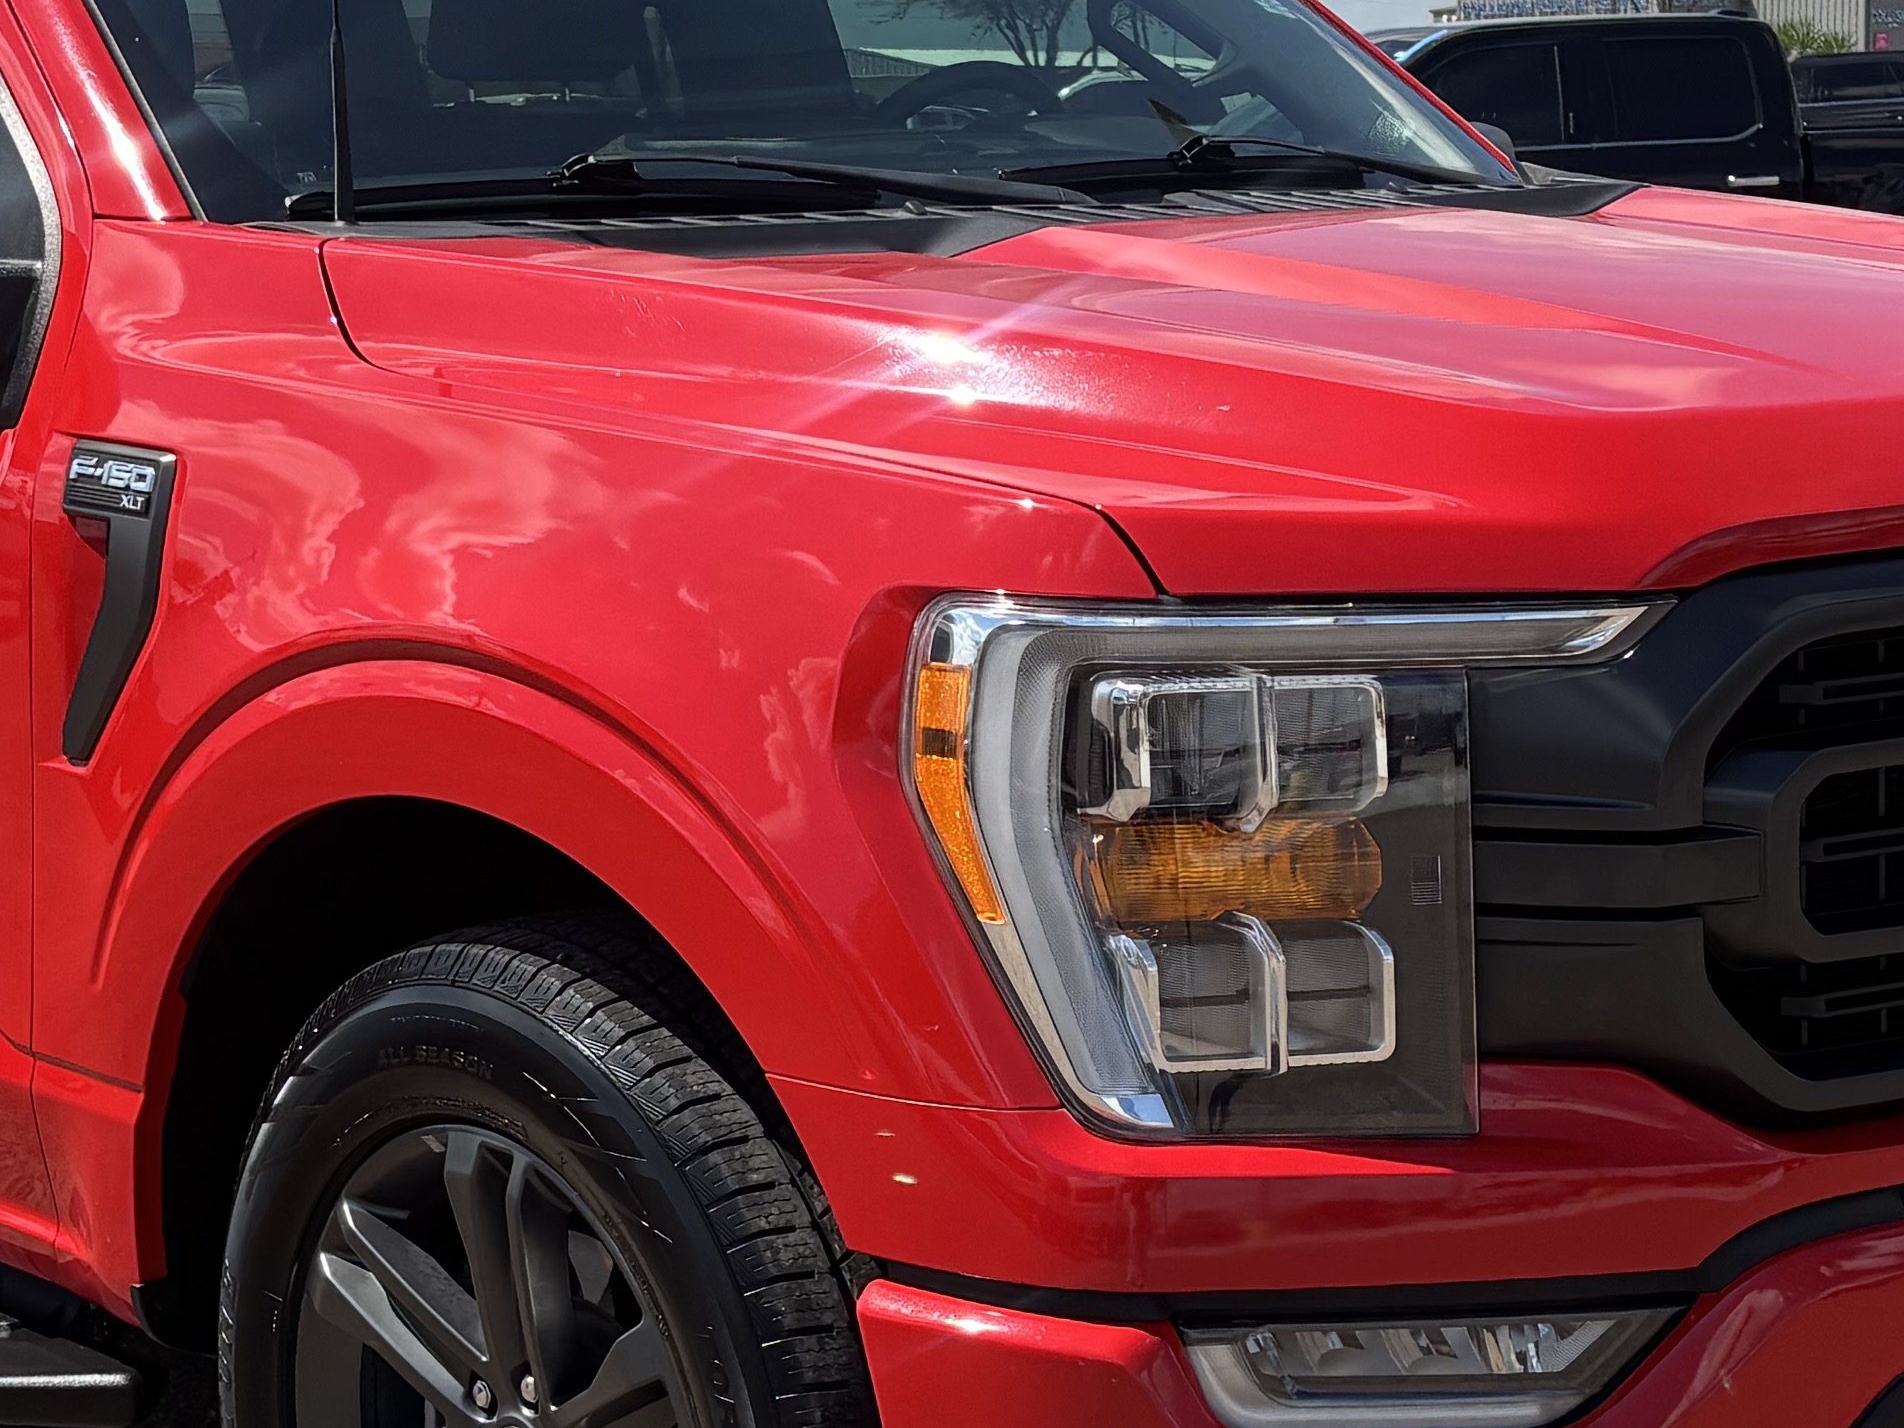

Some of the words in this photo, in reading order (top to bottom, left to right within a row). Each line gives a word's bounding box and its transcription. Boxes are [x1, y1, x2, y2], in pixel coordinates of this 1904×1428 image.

[69, 455, 156, 492] F-150
[119, 494, 145, 510] XLT
[416, 1044, 494, 1080] SEASON
